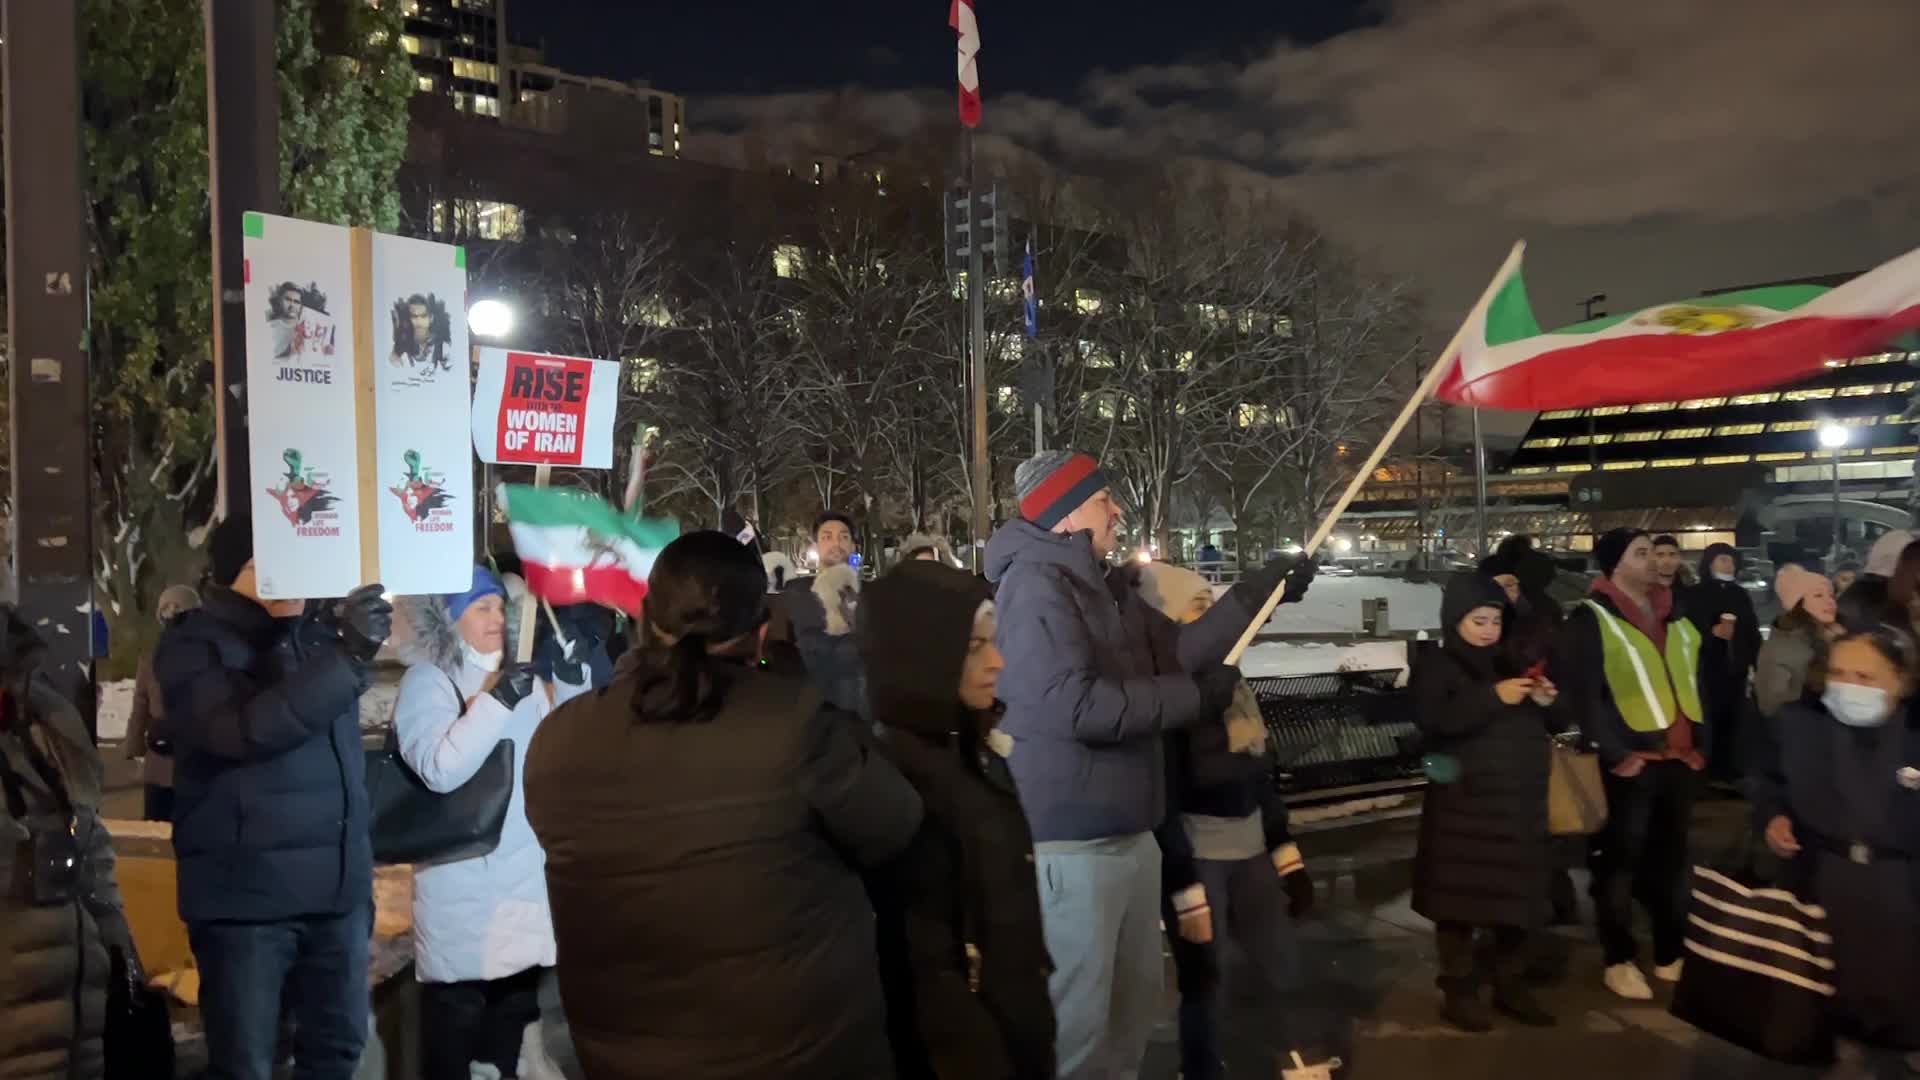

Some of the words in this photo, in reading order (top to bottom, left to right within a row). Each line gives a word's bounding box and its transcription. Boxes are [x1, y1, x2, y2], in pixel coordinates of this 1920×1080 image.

[275, 367, 332, 385] JUSTICE
[511, 366, 585, 403] RISE
[507, 409, 578, 433] WOMEN
[505, 430, 530, 451] OF
[534, 432, 576, 454] IRAN
[296, 527, 340, 537] FREEDOM
[415, 522, 454, 533] FREEDOM
